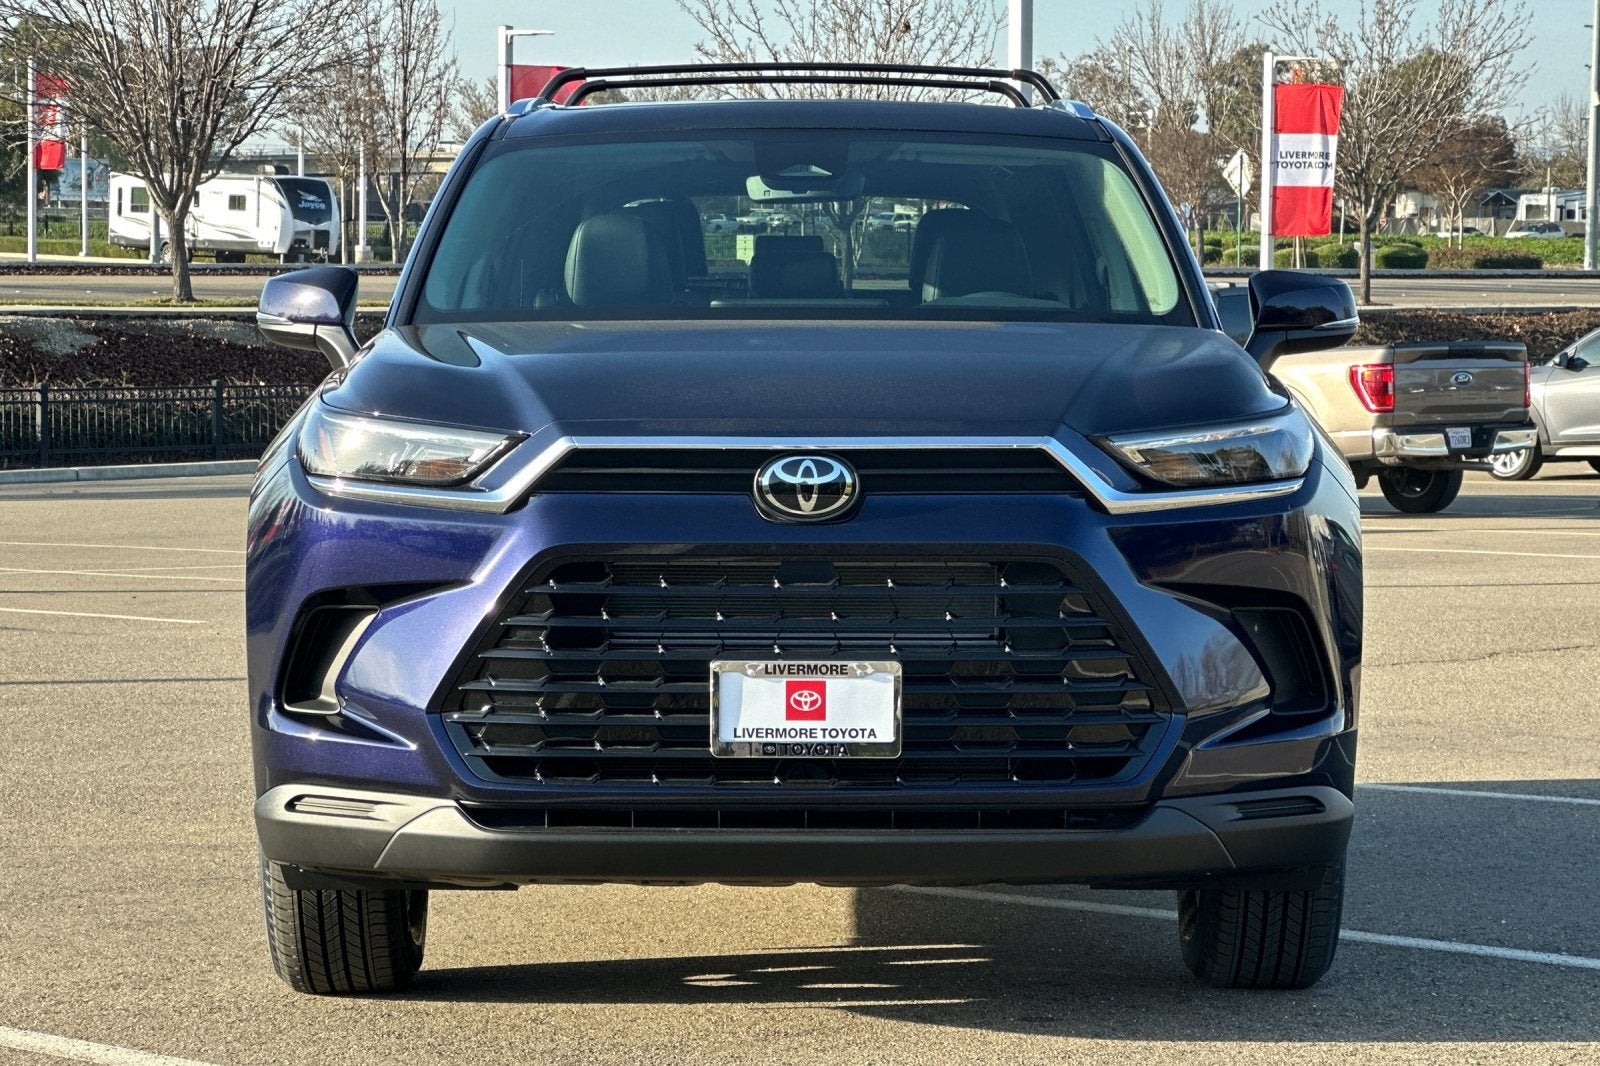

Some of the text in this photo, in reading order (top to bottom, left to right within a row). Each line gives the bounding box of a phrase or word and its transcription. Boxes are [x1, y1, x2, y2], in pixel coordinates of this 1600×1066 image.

[764, 664, 849, 675] LIVERMORE
[733, 727, 877, 739] LIVERMORE TOYOTA
[781, 743, 849, 756] TOYOTA
